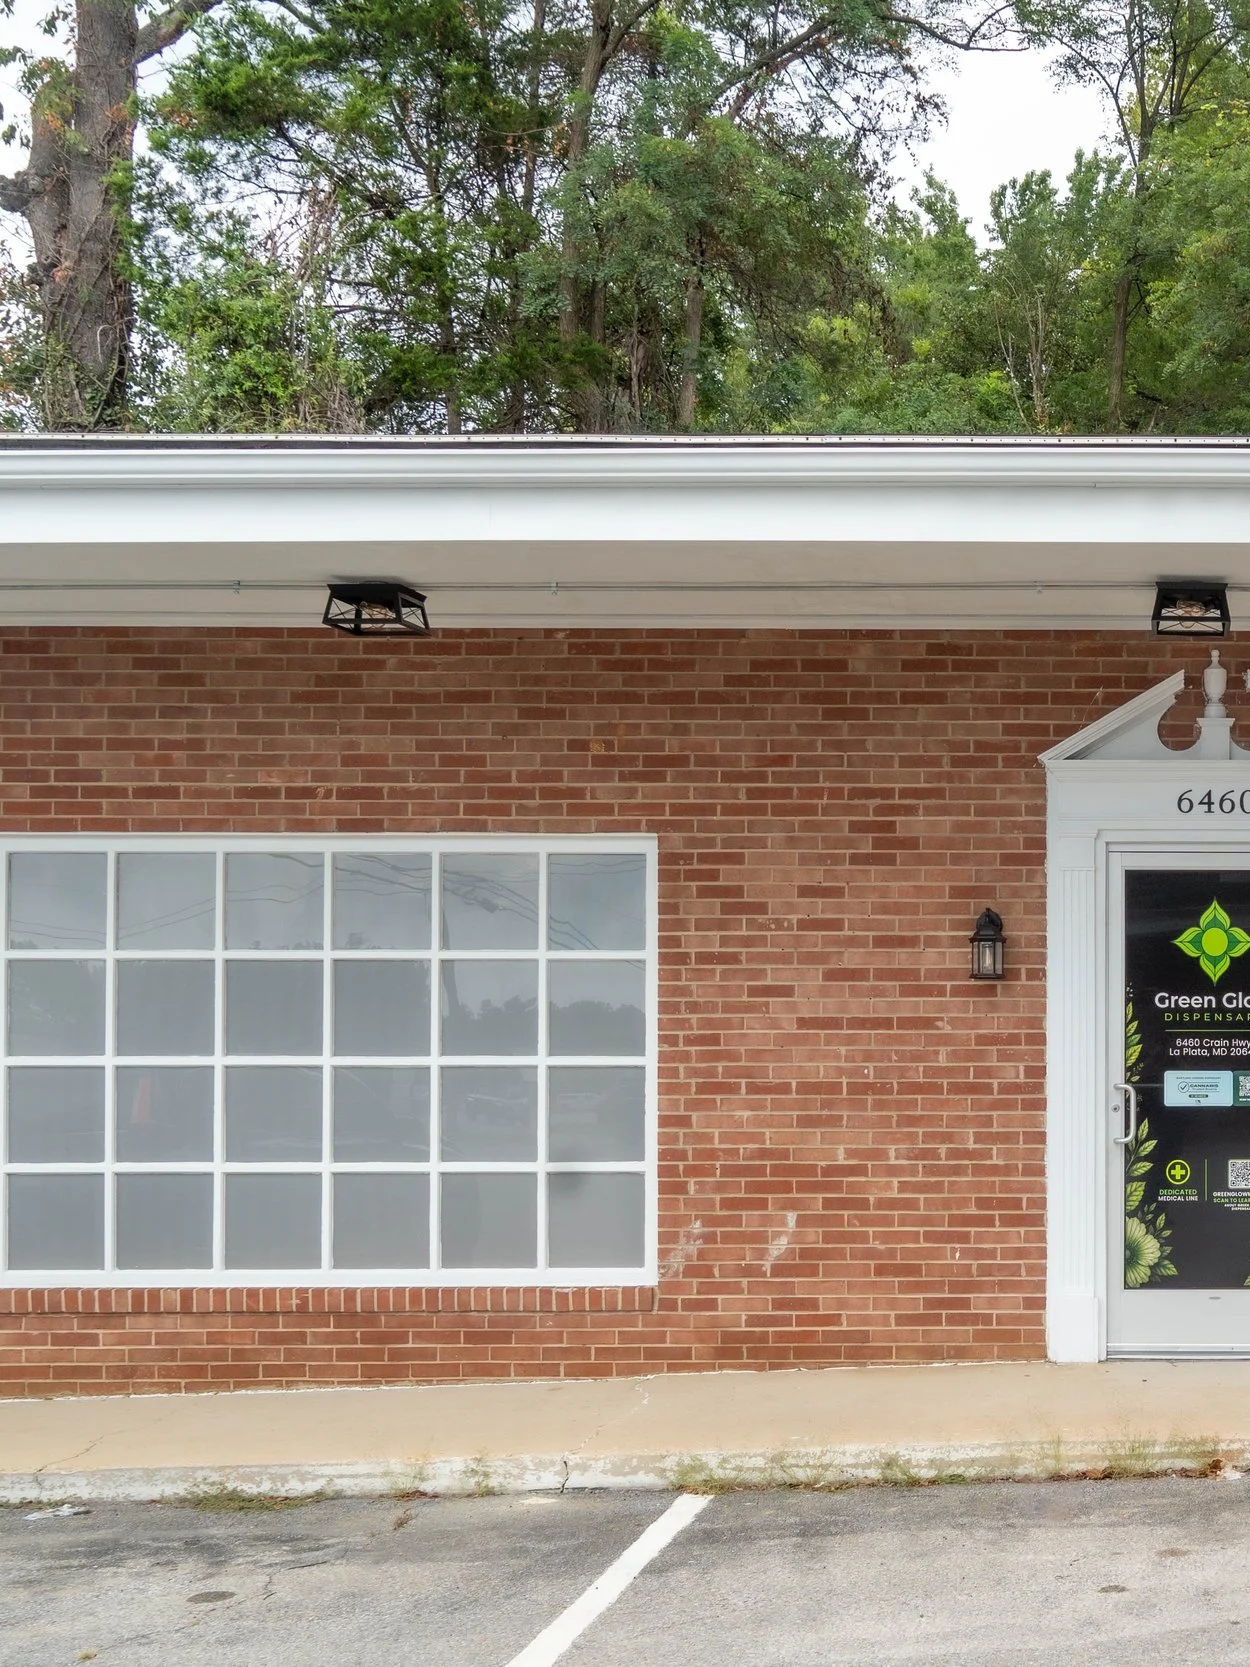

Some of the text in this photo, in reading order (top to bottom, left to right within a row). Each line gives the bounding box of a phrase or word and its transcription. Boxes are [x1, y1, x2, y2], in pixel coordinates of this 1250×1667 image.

[1154, 992, 1216, 1009] Green
[1176, 1038, 1200, 1046] 6460
[1202, 1038, 1230, 1046] Crain
[1169, 1048, 1180, 1056] La
[1182, 1048, 1210, 1056] Plata,
